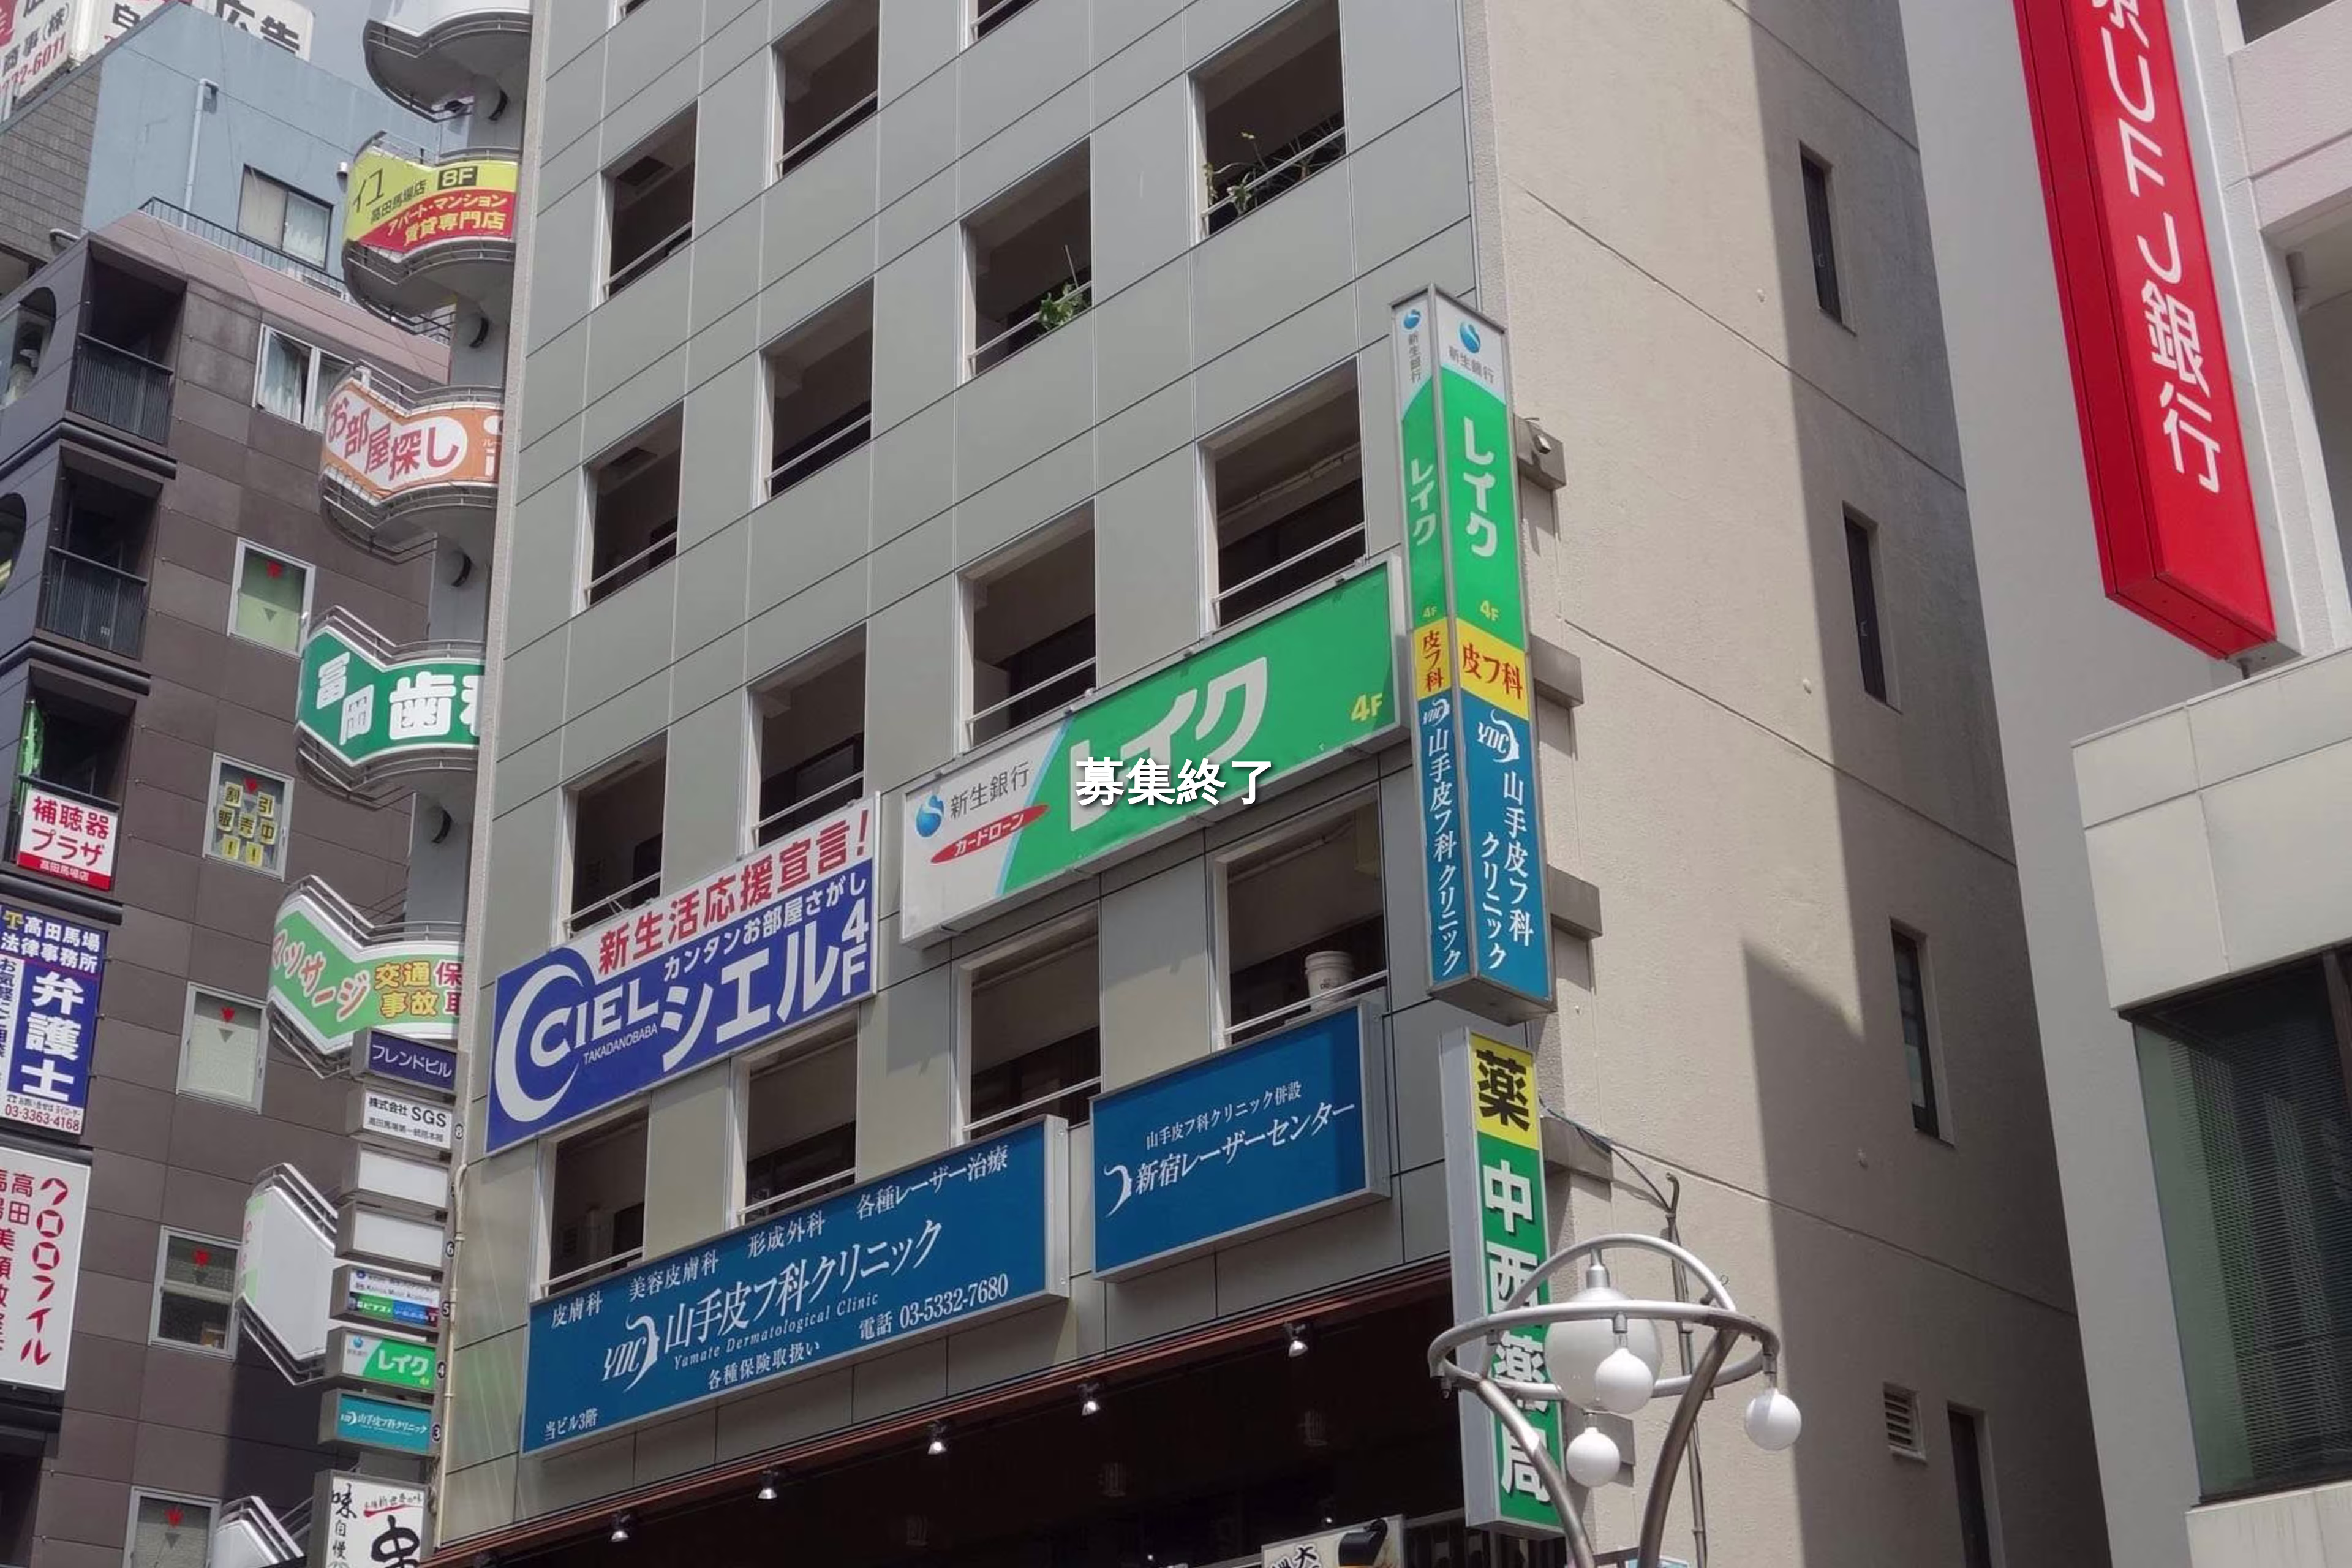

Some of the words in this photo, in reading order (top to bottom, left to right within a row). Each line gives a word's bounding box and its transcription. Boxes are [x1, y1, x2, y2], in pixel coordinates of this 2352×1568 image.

[442, 170, 473, 186] 8F
[388, 194, 507, 236] アパート・マンション
[404, 211, 507, 246] 賃貸専門店
[1448, 345, 1494, 385] 新生銀行
[328, 396, 459, 481] お部屋探し
[1411, 458, 1436, 545] レイク
[1463, 417, 1498, 557] レイク
[1423, 606, 1437, 619] 4F
[1480, 600, 1499, 623] 4F
[1422, 629, 1443, 692] 皮フ科
[1463, 642, 1523, 700] 皮フ科
[1351, 692, 1383, 722] 4F
[1069, 656, 1268, 831] レイク
[950, 761, 1030, 820] 新生銀行
[33, 796, 109, 840] 補聴器
[954, 813, 1024, 857] カードローン
[32, 829, 105, 867] プラザ
[40, 861, 89, 882] 高田馬場店
[1504, 771, 1534, 946] 山手皮フ科
[1480, 831, 1507, 969] クリニック
[24, 916, 100, 952] 高田馬場
[665, 871, 867, 982] カンタンお部屋さがし
[1, 932, 99, 974] 法律事務所
[374, 962, 431, 989] 交通
[380, 990, 439, 1018] 事故
[661, 921, 839, 1073] シエル
[20, 971, 85, 1102] 弁護士
[372, 1044, 452, 1077] フレンドビル
[583, 1023, 658, 1066] TAKADANOBABA
[369, 1096, 408, 1117] 株式会社
[412, 1106, 447, 1128] SGS
[1476, 1049, 1530, 1133] 薬
[1136, 1102, 1355, 1195] 新宿レーザーセンター
[858, 1145, 1008, 1221] 各種レーザー治療
[748, 1210, 826, 1260] 形成外科
[628, 1251, 720, 1300] 美容皮膚科
[665, 1219, 942, 1355] 山手皮フ科クリニック
[551, 1292, 603, 1330] 皮膚科
[674, 1347, 720, 1370] Yamate
[726, 1310, 830, 1356] Dermatological
[837, 1293, 880, 1319] Clinic
[859, 1313, 893, 1341] 電話
[900, 1274, 1009, 1327] 03-5332-7680
[378, 1349, 428, 1376] レイク
[708, 1341, 820, 1391] 各種保険取扱い
[545, 1409, 598, 1442] 当ビル3階
[331, 1483, 357, 1568] 味自慢
